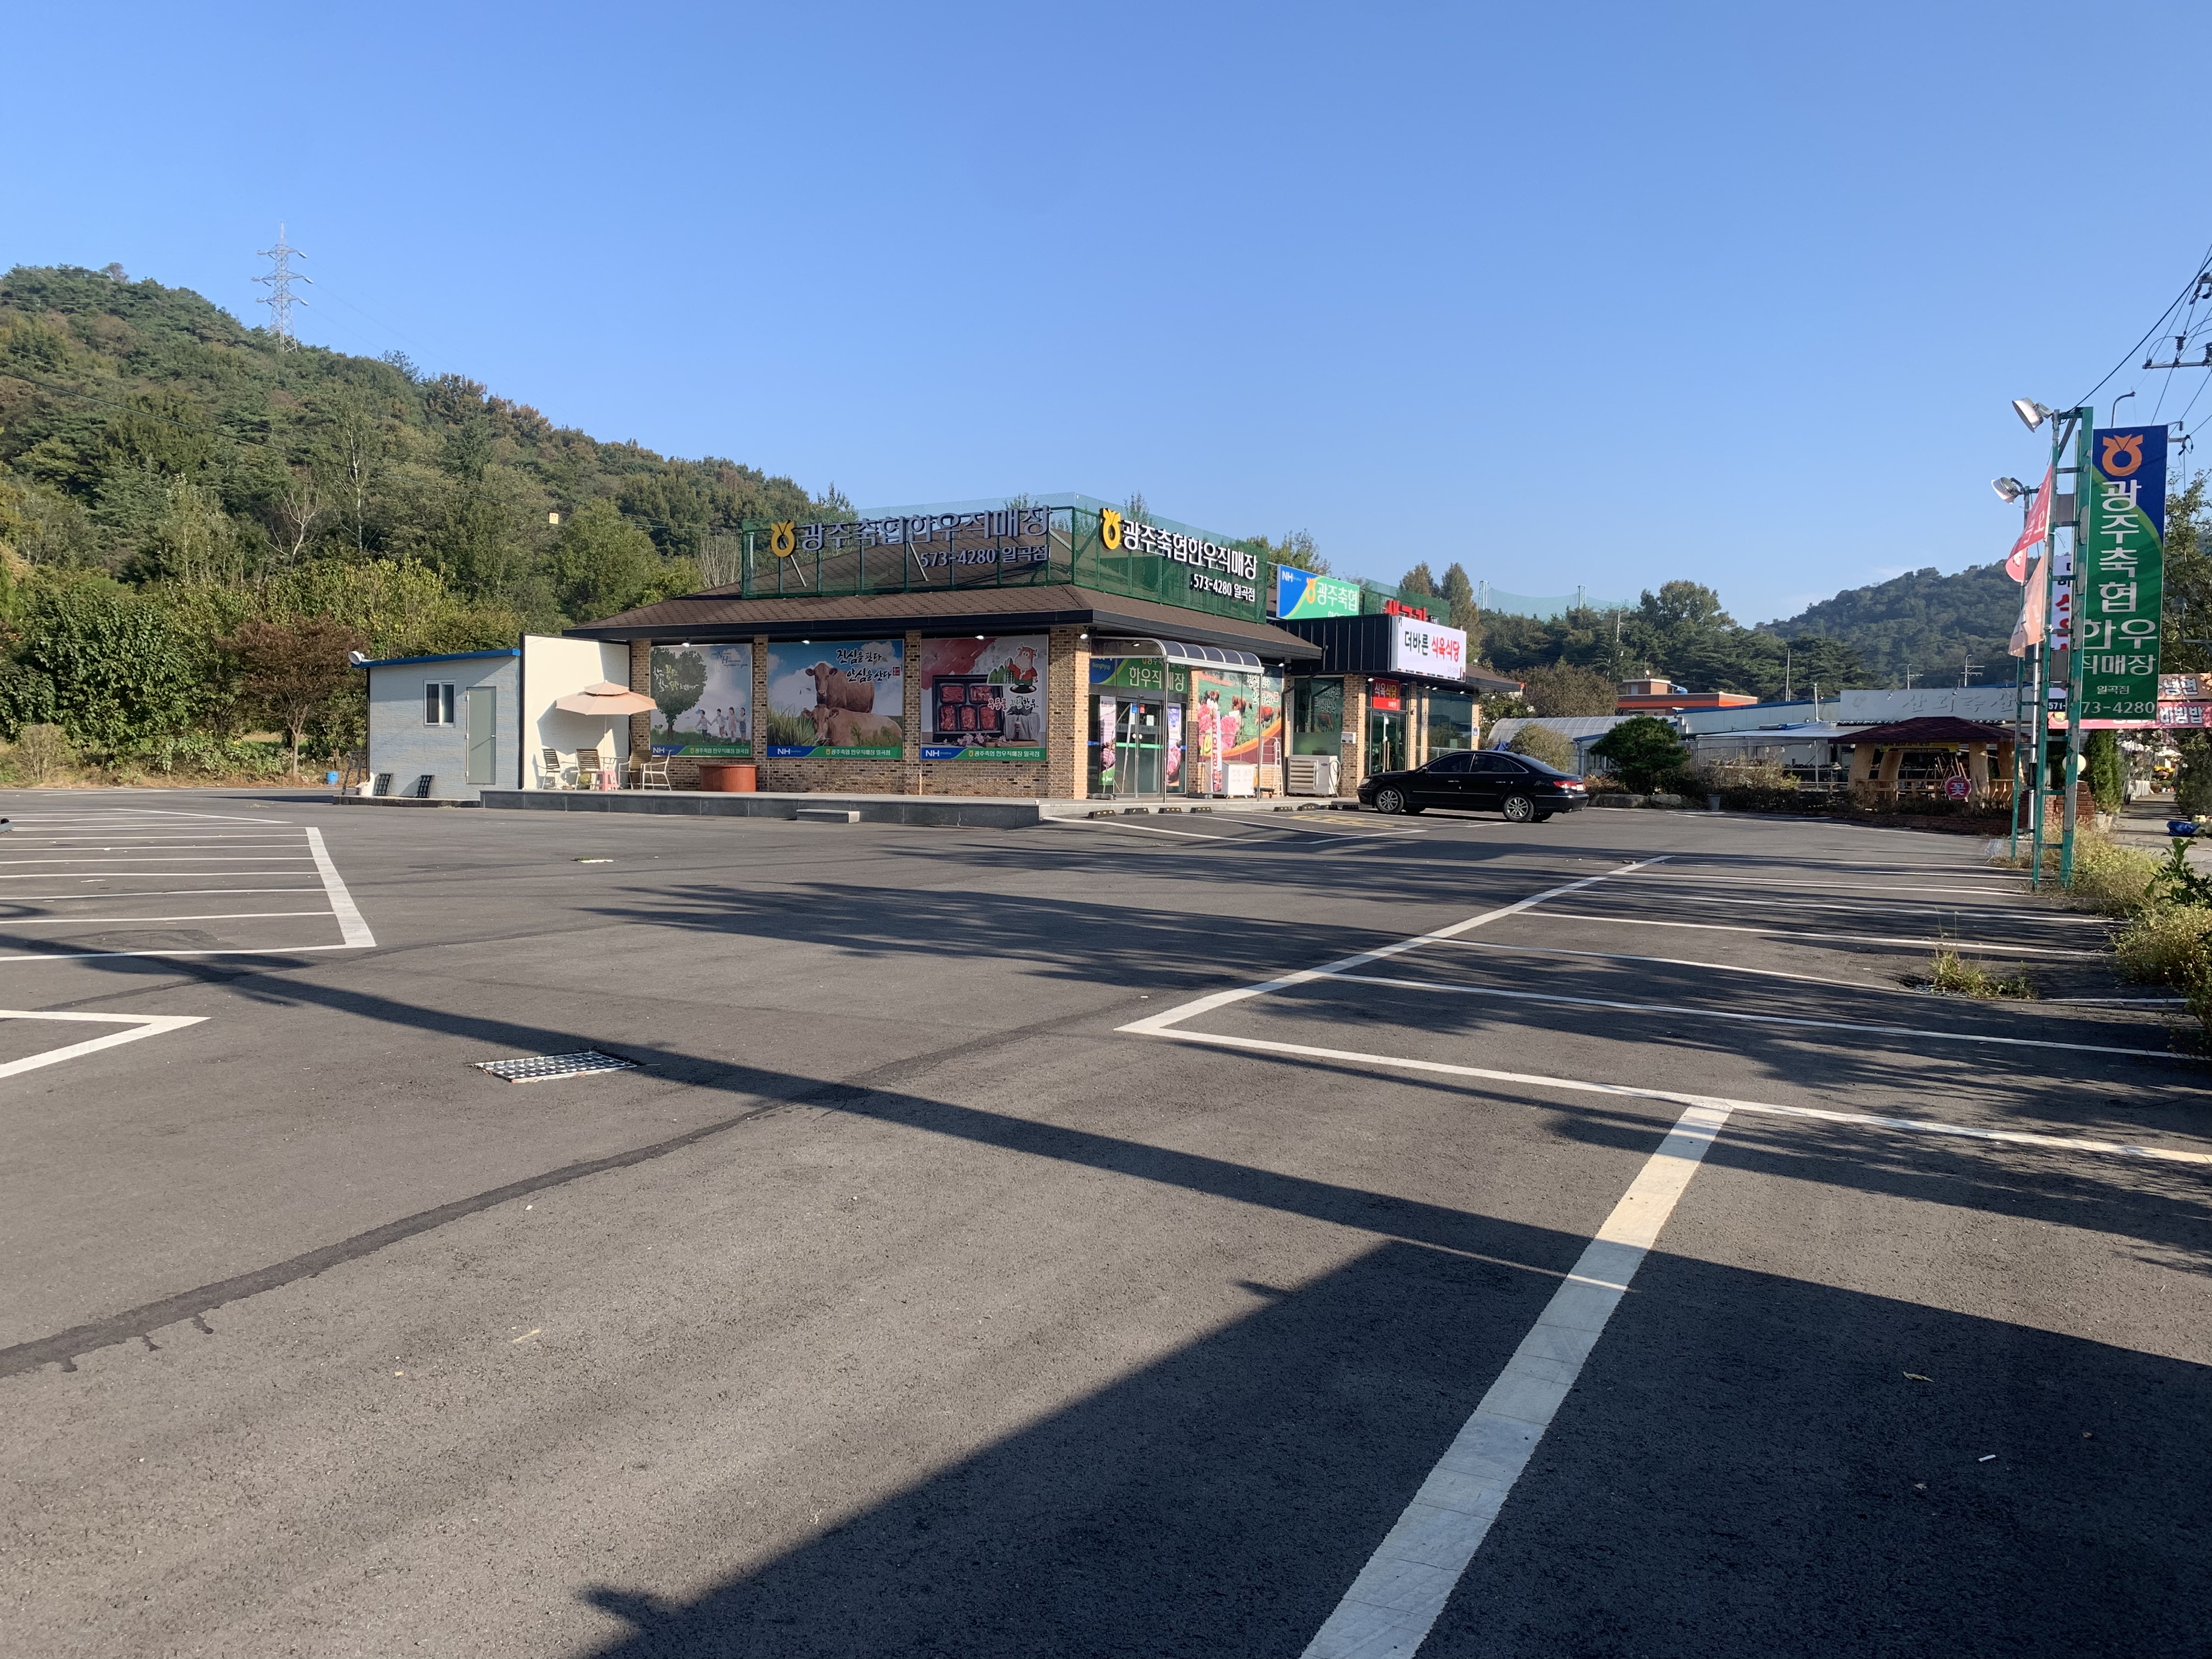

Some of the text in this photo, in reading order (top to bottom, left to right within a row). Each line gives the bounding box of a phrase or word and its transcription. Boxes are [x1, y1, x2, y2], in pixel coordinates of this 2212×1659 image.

[800, 505, 1052, 551] 광주축협한우직매장
[921, 544, 1049, 567] 573-4280 일곡점
[1124, 520, 1257, 580] 광주축협한우직매장
[2098, 479, 2142, 613] 광주축협
[1282, 571, 1293, 583] NH
[1193, 574, 1255, 602] 573-4280 일곡점
[1317, 582, 1358, 612] 광주축협
[2084, 619, 2158, 650] 한우
[1404, 631, 1460, 662] 더바른 식육식당
[837, 649, 882, 665] 진심을 판다
[2083, 654, 2157, 676] 직매장
[847, 668, 873, 684] 안심을
[874, 669, 892, 681] 산다
[1375, 682, 1397, 699] 식육식당
[2097, 685, 2130, 695] 일곡점
[2158, 678, 2199, 696] 냉면
[2082, 701, 2155, 714] 73-4280
[2159, 706, 2203, 724] 비빔밥
[1950, 782, 1967, 795] 꽃
